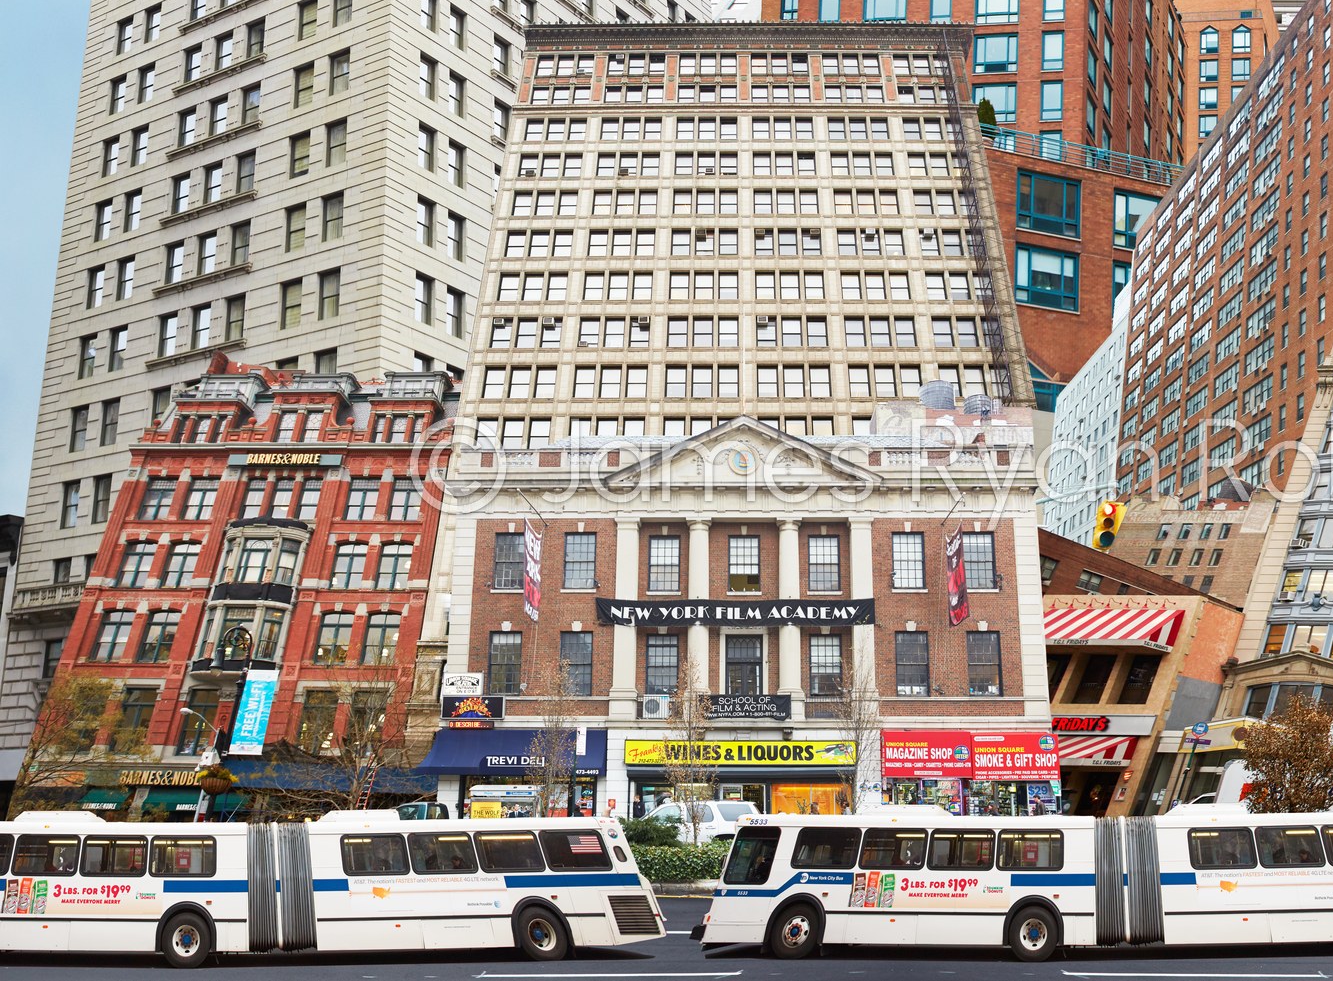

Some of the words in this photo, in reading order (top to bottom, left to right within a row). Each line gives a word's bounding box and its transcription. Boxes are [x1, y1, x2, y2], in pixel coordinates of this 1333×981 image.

[610, 606, 652, 620] NEW
[658, 606, 711, 620] YORK
[715, 606, 762, 620] FILM
[767, 606, 860, 619] ACADEMY
[718, 696, 757, 704] SCHOOL
[759, 696, 771, 704] OF
[712, 704, 733, 712] FILM
[241, 712, 255, 737] FREE
[664, 745, 721, 761] WINES
[724, 746, 735, 761] &
[737, 745, 814, 762] LIQUORS
[886, 748, 929, 759] MAGAZINE
[930, 748, 953, 759] SHOP
[486, 756, 517, 766] TREVI
[521, 756, 546, 766] DELI
[974, 754, 1004, 767] SMOKE
[1006, 754, 1013, 767] &
[1014, 754, 1033, 767] GIFT
[1035, 754, 1058, 767] SHOP
[120, 770, 202, 786] BARNES&NOBL
[1028, 785, 1048, 797] $29
[54, 884, 62, 897] 3
[901, 878, 909, 891] 3
